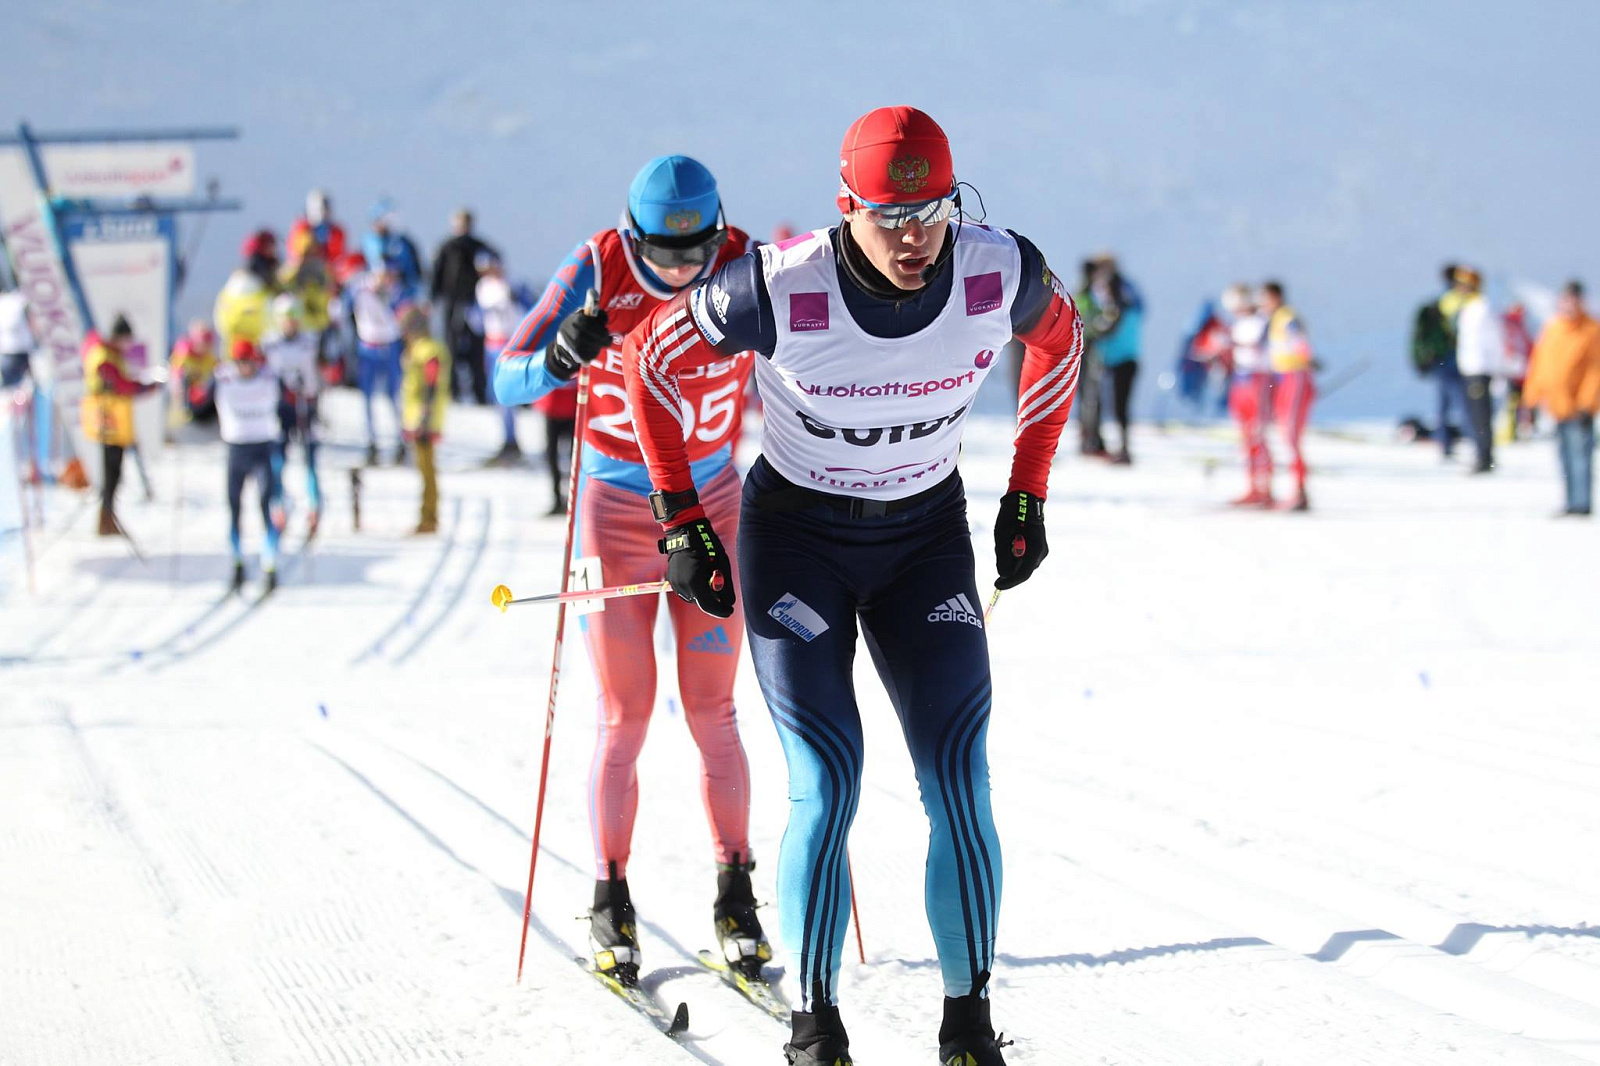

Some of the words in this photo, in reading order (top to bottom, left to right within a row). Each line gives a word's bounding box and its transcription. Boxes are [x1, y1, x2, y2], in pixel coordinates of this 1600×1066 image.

[796, 370, 976, 398] vuokattisport
[1017, 493, 1028, 522] LEKI
[696, 524, 716, 557] LEKI
[780, 613, 816, 641] GAZPROM
[927, 609, 983, 629] adidas
